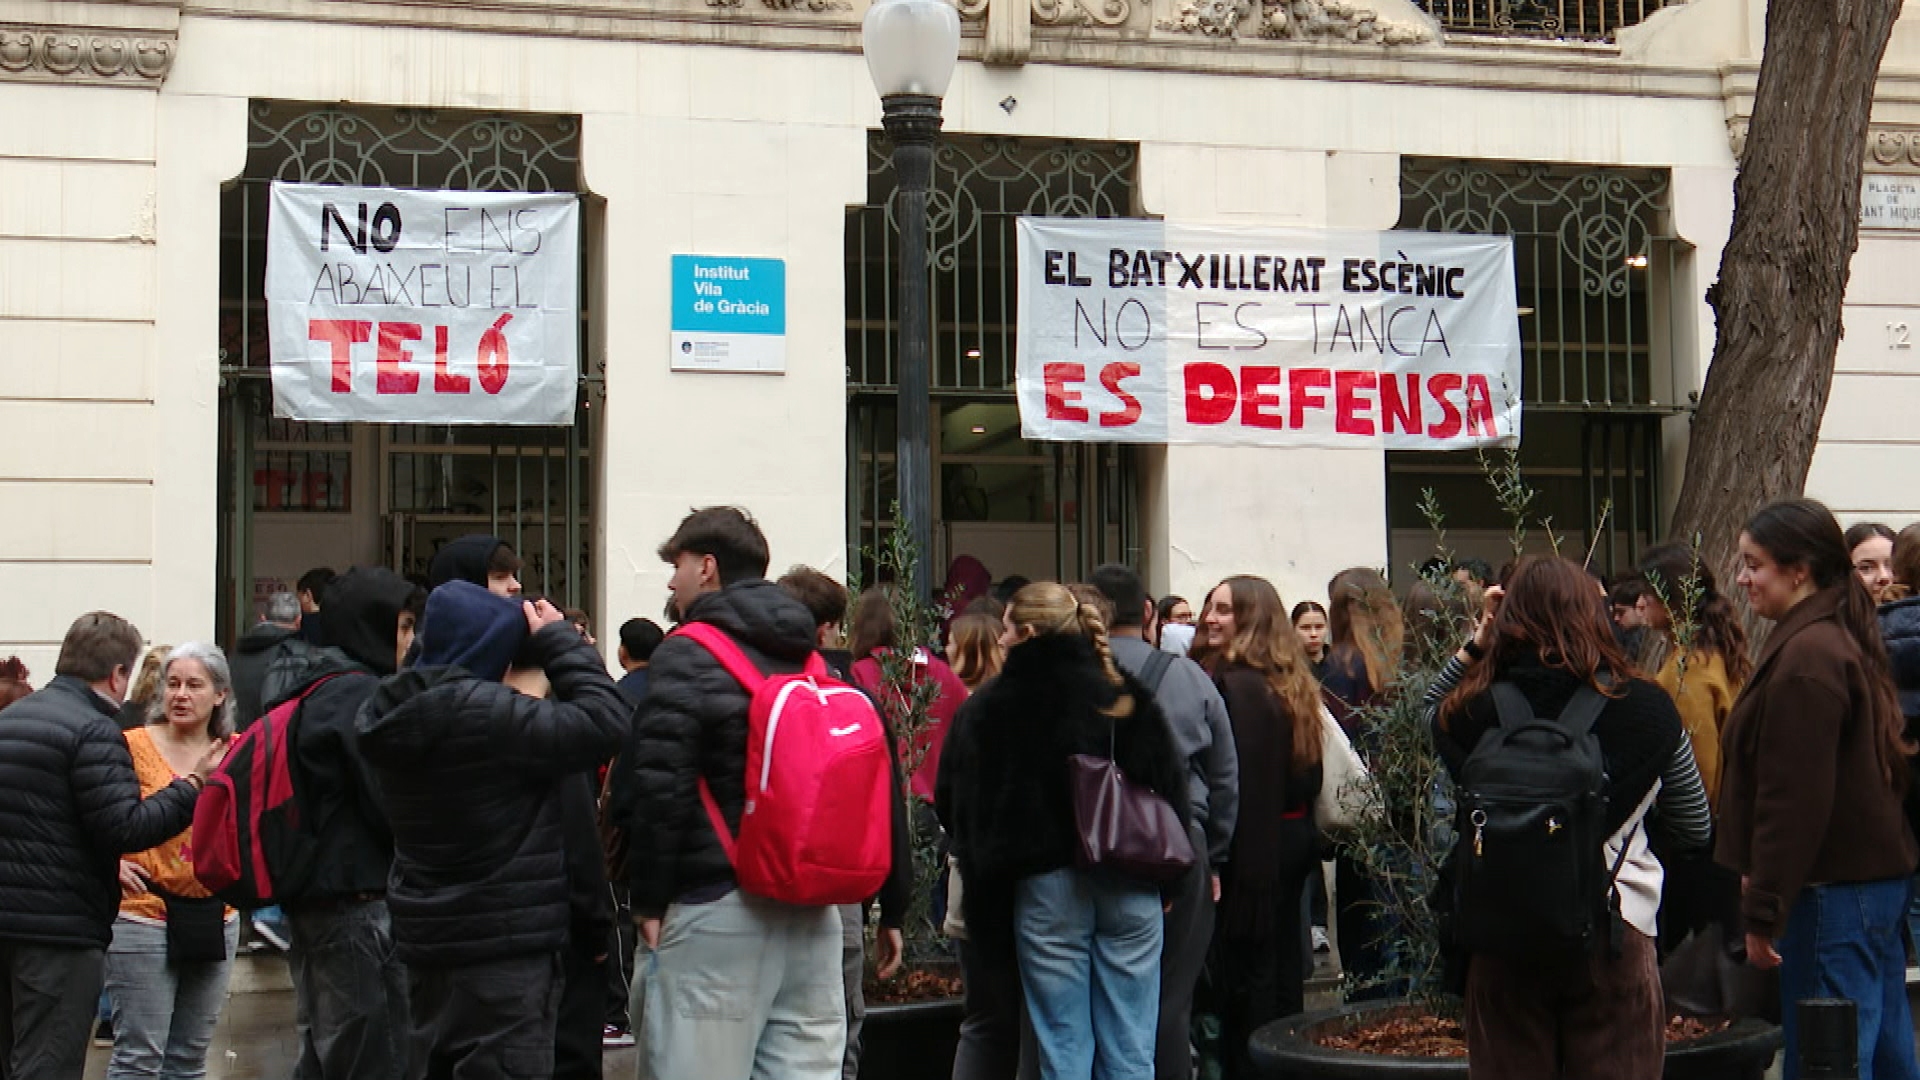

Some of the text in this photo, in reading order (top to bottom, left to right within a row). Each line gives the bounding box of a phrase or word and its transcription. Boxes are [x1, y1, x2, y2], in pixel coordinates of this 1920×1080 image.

[1868, 182, 1916, 194] PLACETA
[1886, 194, 1900, 205] DE
[320, 201, 542, 255] NO ENS
[309, 263, 538, 309] ABAIXEU EL
[693, 263, 750, 281] Institut
[693, 281, 722, 296] Vila
[1044, 248, 1466, 299] EL BATXILLERAT ESCÈNIC
[693, 298, 770, 315] de Gràcia
[1073, 298, 1451, 357] NO ES TANCA
[1885, 321, 1912, 351] 12
[308, 312, 514, 395] TELÓ
[1043, 360, 1500, 439] ES DEFENSA
